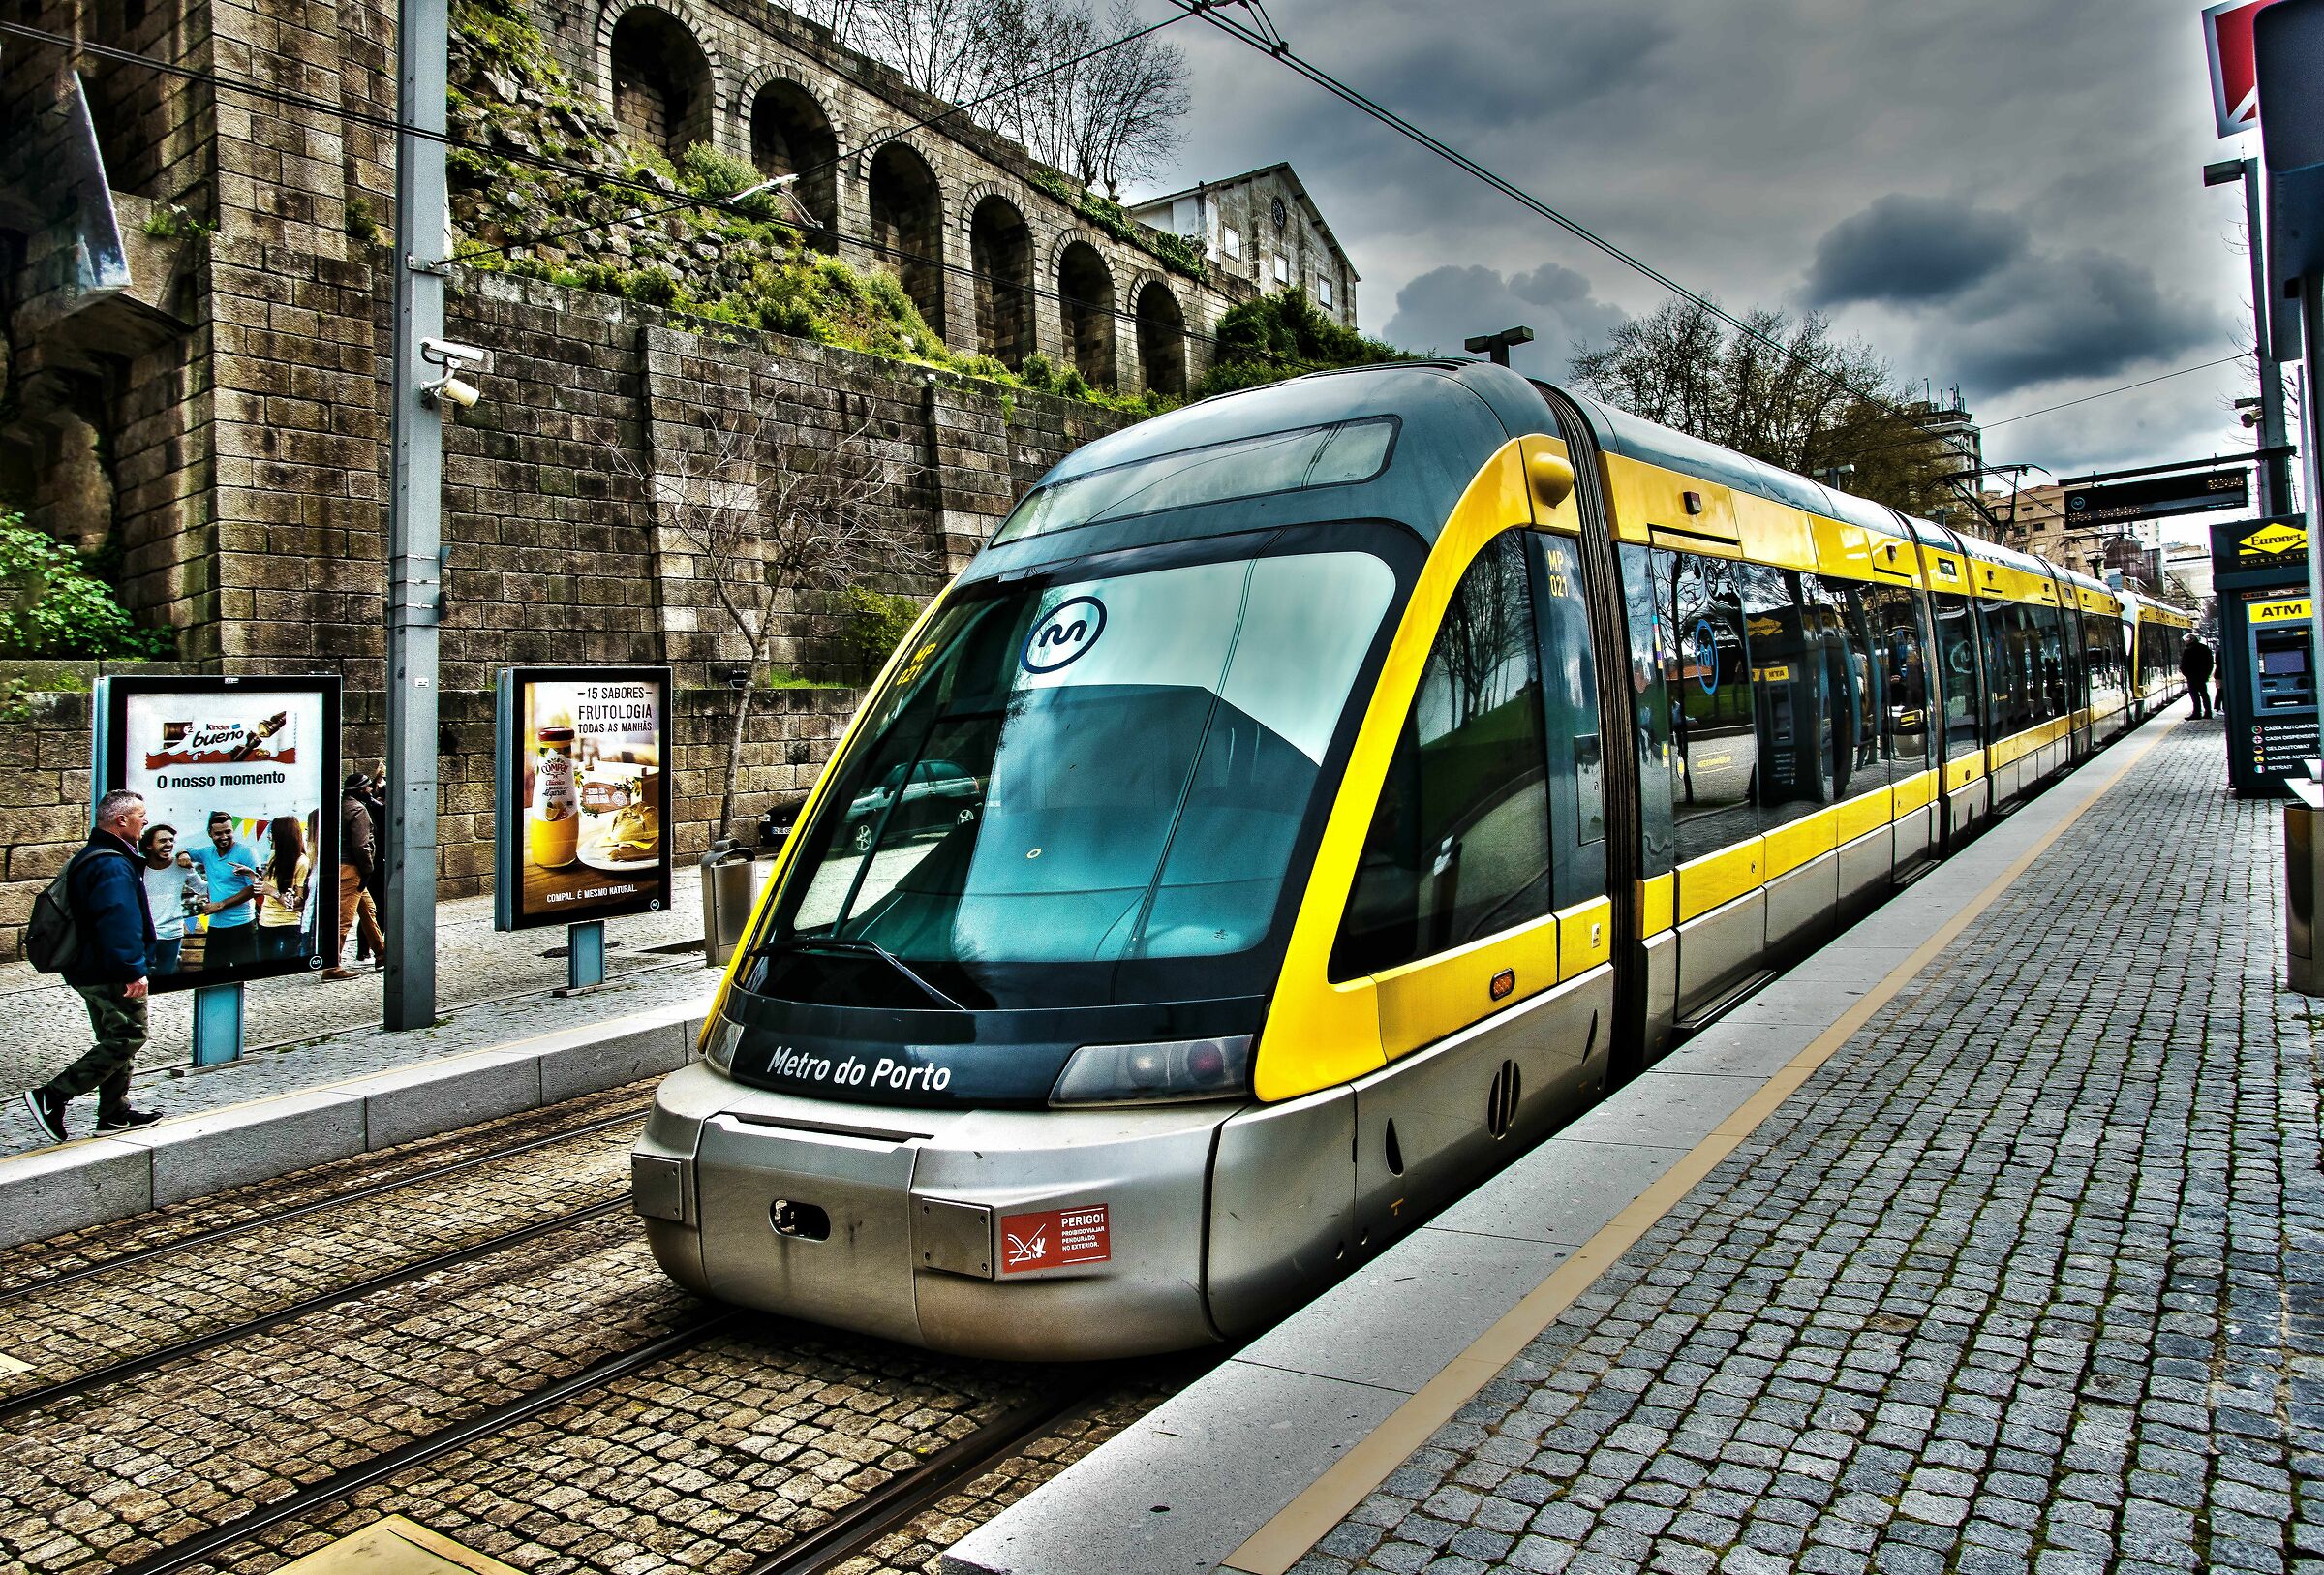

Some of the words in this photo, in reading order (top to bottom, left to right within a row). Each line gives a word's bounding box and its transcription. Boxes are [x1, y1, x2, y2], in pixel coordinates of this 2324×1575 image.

[2250, 533, 2302, 546] Euronet
[1547, 549, 1564, 571] MP
[1549, 574, 1569, 598] 021
[2261, 603, 2303, 618] ATM
[910, 642, 937, 664] MP
[896, 663, 924, 686] 021
[578, 703, 653, 720] FRUTOLOGIA
[577, 723, 605, 733] TODAS
[608, 723, 618, 732] AS
[621, 720, 653, 732] MANHÃS
[192, 730, 244, 748] bueno
[156, 775, 168, 789] O
[171, 776, 216, 788] nosso
[220, 771, 286, 786] momento
[546, 891, 575, 903] COMPAL.
[584, 887, 608, 899] MESMO
[609, 883, 638, 895] NATURAL.
[766, 1045, 831, 1081] Metro
[833, 1055, 866, 1086] do
[870, 1057, 952, 1091] Porto
[1061, 1213, 1104, 1227] PERIGO!
[1061, 1234, 1096, 1244] PENDURADO
[1071, 1241, 1100, 1250] EXTERIOR.
